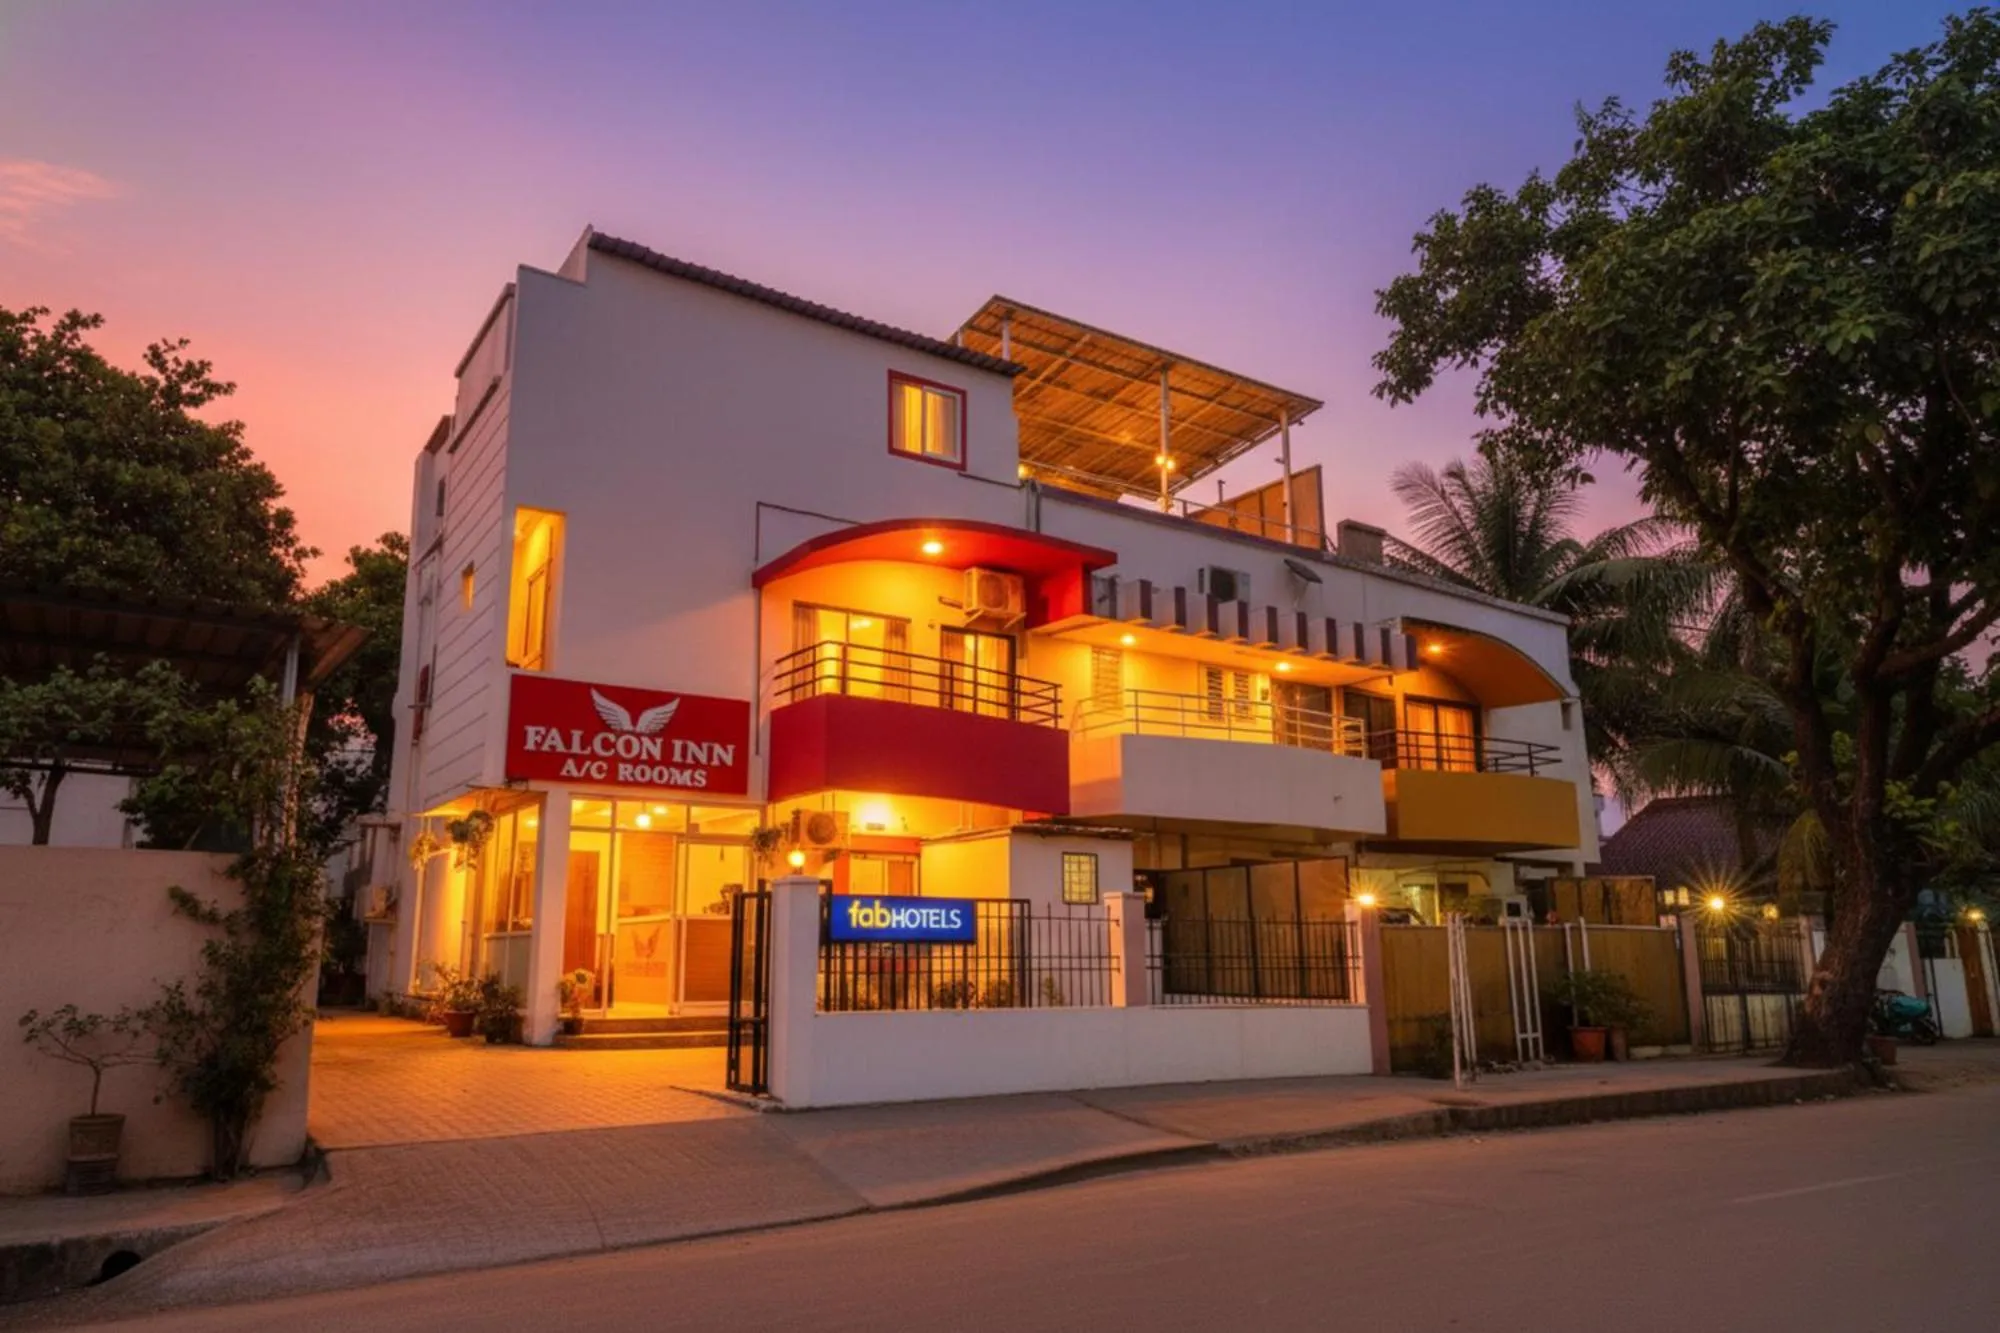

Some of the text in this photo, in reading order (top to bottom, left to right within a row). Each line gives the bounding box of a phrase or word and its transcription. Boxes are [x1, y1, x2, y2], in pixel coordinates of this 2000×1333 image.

[523, 726, 735, 766] FALCON INN
[560, 758, 708, 788] A/C ROOMS
[848, 900, 961, 929] fabHOTELS
